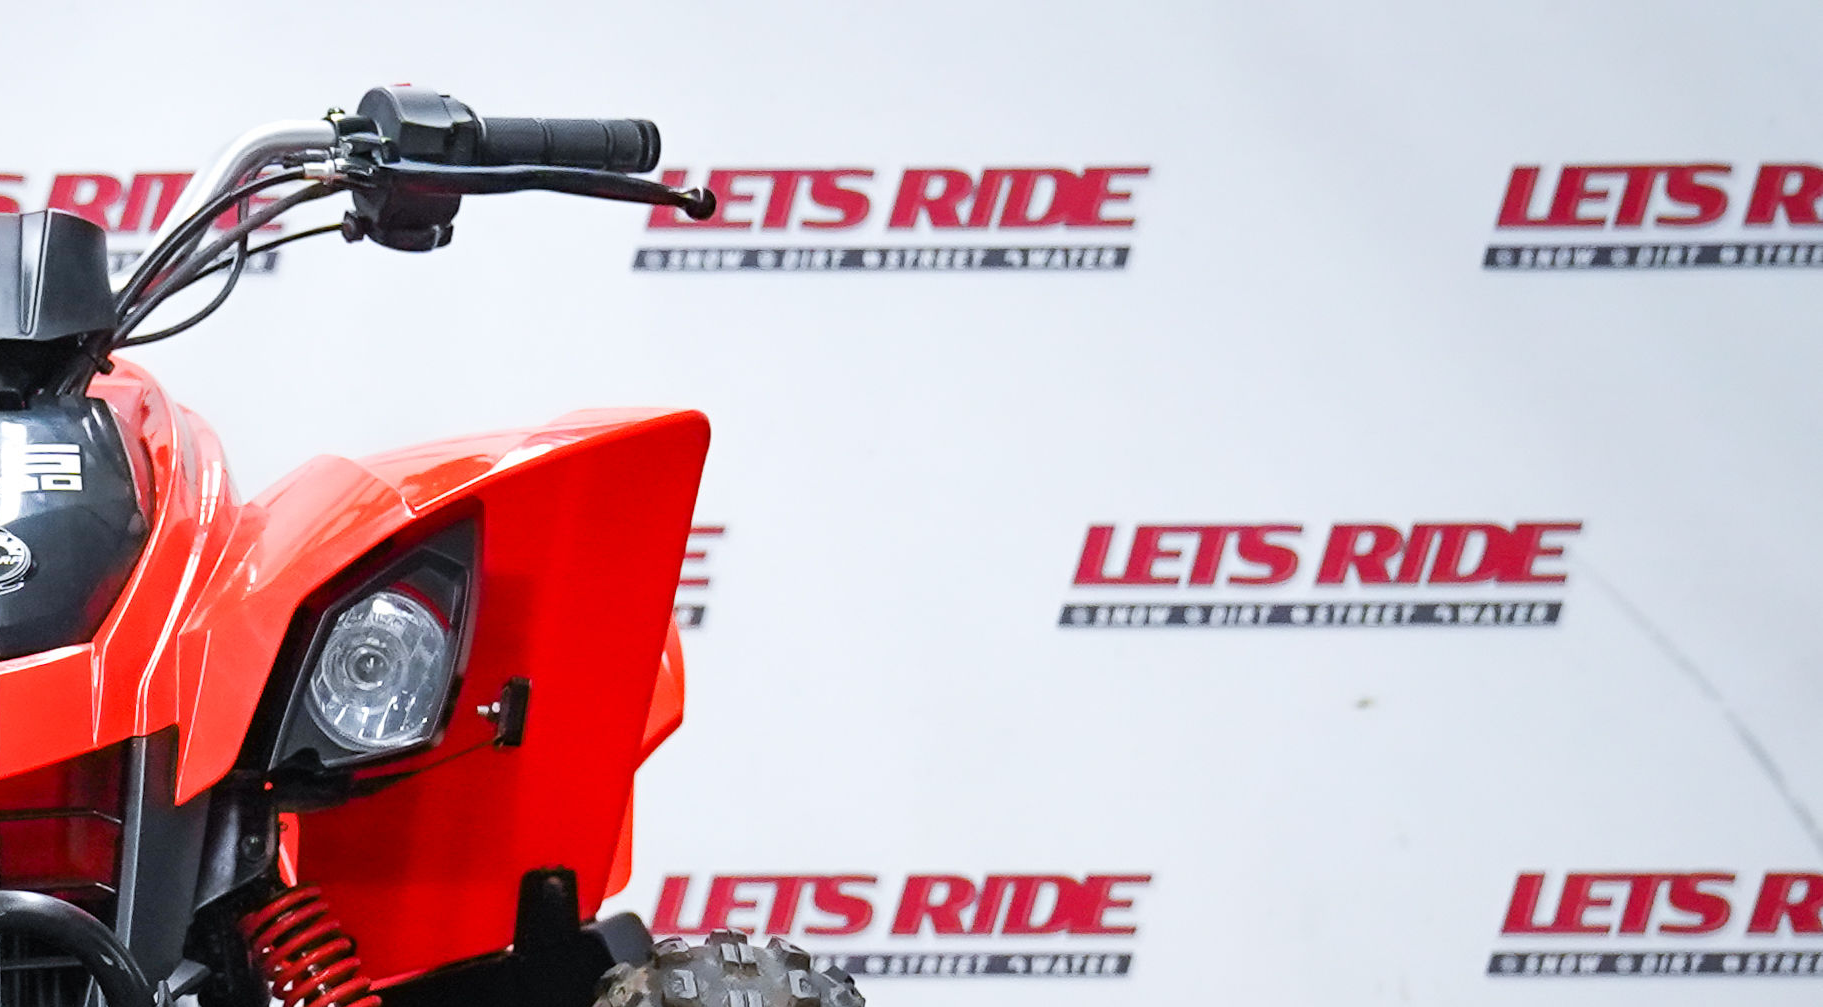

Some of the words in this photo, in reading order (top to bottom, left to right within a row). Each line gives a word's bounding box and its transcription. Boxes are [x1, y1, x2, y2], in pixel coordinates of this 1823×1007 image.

[648, 169, 874, 229] LETS
[888, 167, 1150, 228] RIDE
[1497, 165, 1731, 226] LETS
[1073, 525, 1302, 585] LETS
[1316, 522, 1581, 584] RIDE
[650, 875, 877, 936] LETS
[891, 874, 1152, 935] RIDE
[1500, 873, 1735, 934] LETS
